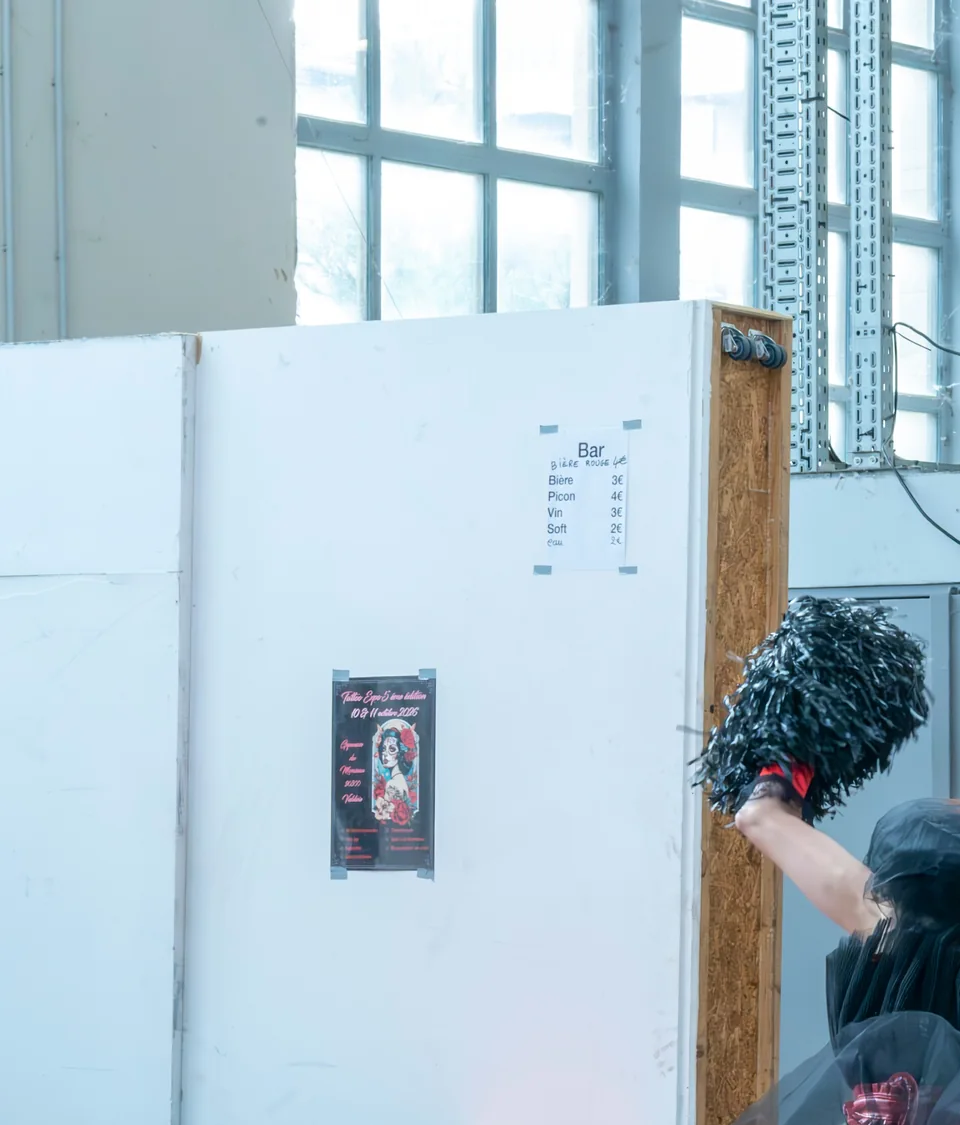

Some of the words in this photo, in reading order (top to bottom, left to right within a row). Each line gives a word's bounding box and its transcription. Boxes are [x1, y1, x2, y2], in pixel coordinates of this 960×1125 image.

[578, 442, 605, 458] Bar
[585, 459, 609, 467] ROUGE
[548, 475, 574, 486] Bière
[611, 475, 624, 485] 3€
[548, 491, 576, 502] Picon
[610, 491, 623, 501] 4€
[547, 507, 563, 518] Vin
[610, 507, 623, 518] 3€
[547, 523, 567, 534] Soft
[610, 523, 623, 534] 2€
[381, 690, 391, 702] 5
[351, 708, 359, 718] 10
